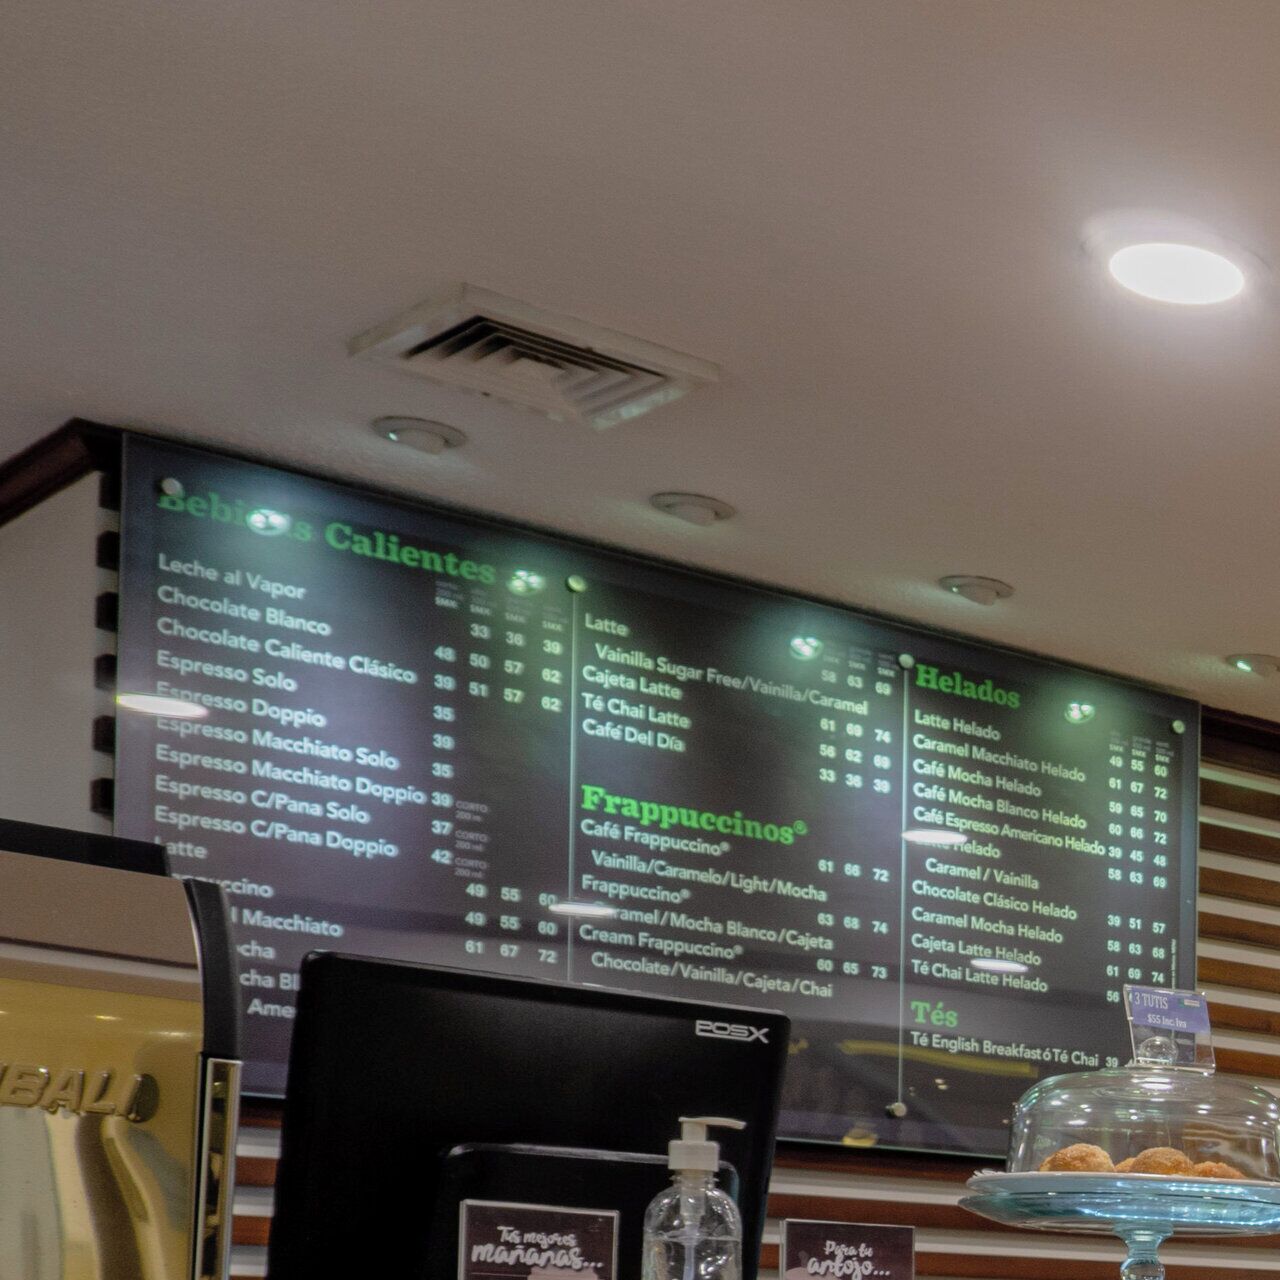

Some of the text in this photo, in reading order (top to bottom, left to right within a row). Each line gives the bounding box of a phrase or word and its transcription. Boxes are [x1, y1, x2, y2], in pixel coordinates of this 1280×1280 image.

[324, 521, 497, 585] Calientes
[158, 553, 307, 600] Leche al Vapor
[157, 584, 333, 637] Chocolate Blanco
[584, 612, 630, 638] Latte
[156, 616, 418, 685] Chocolate Caliente Clásico
[469, 652, 490, 670] 50
[503, 659, 524, 675] 57
[541, 667, 562, 685] 62
[156, 649, 299, 693] Espresso Solo
[582, 664, 683, 700] Cajeta Latte
[594, 642, 869, 716] Vainilla Sugar Free/Vainilla/Caramel
[915, 664, 1021, 709] Helados
[156, 680, 328, 729] Espresso Doppio
[469, 681, 489, 698] 51
[503, 687, 524, 704] 57
[541, 696, 562, 713] 62
[581, 692, 692, 730] Té Chai Latte
[582, 718, 686, 753] Café Del Día
[914, 708, 1001, 741] Latte Helado
[157, 717, 401, 771] Espresso Macchiato Solo
[913, 733, 1086, 782] Caramel Macchiato Helado
[155, 743, 428, 806] Espresso Macchiato Doppio
[913, 758, 1042, 797] Café Mocha Helado
[155, 774, 371, 825] Espresso C/Pana Solo
[913, 782, 1087, 829] Café Mocha Blanco Helado
[154, 804, 399, 859] Espresso C/Pana Doppio
[431, 819, 454, 836] 37
[580, 818, 622, 840] Café
[913, 806, 1106, 855] Café Espresso Americano Helado
[430, 848, 453, 865] 42
[954, 840, 1001, 859] Helado
[925, 857, 982, 879] Caramel
[993, 868, 1040, 890] Vainilla
[912, 879, 1078, 920] Chocolate Clásico Helado
[243, 908, 344, 937] Macchiato
[579, 924, 636, 946] Cream
[912, 906, 1064, 944] Caramel Mocha Helado
[911, 933, 1042, 966] Cajeta Latte Helado
[911, 959, 1048, 992] Té Chai Latte Helado
[1106, 965, 1164, 984] 61 69 74
[910, 1000, 959, 1028] Tés
[1134, 992, 1168, 1009] 3 TUTIS
[1147, 1013, 1160, 1024] $55
[910, 1031, 1099, 1067] Té English Breakfast ó Té Chai
[0, 1063, 143, 1122] BALI
[497, 1225, 577, 1249] Tus mejores
